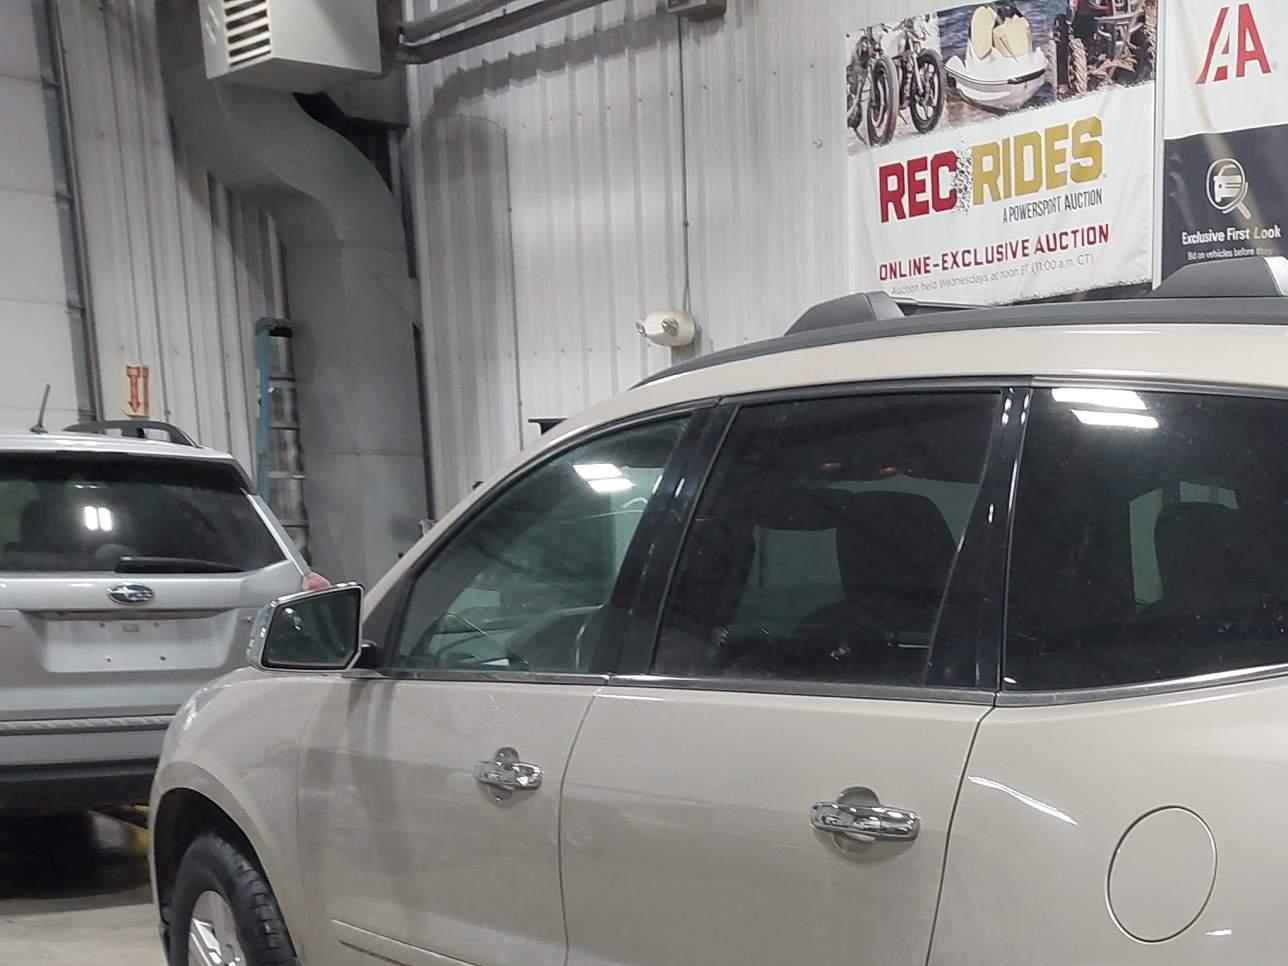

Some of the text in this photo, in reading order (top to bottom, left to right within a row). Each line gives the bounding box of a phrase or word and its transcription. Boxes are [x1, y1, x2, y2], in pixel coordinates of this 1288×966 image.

[879, 116, 1103, 223] REC RIDES
[1009, 196, 1062, 222] POWERSPORT
[1064, 188, 1103, 212] AUCTION
[880, 223, 1109, 281] ONLINE-EXCLUSIVE AUCTION
[1181, 224, 1281, 246] Exclusive First Look
